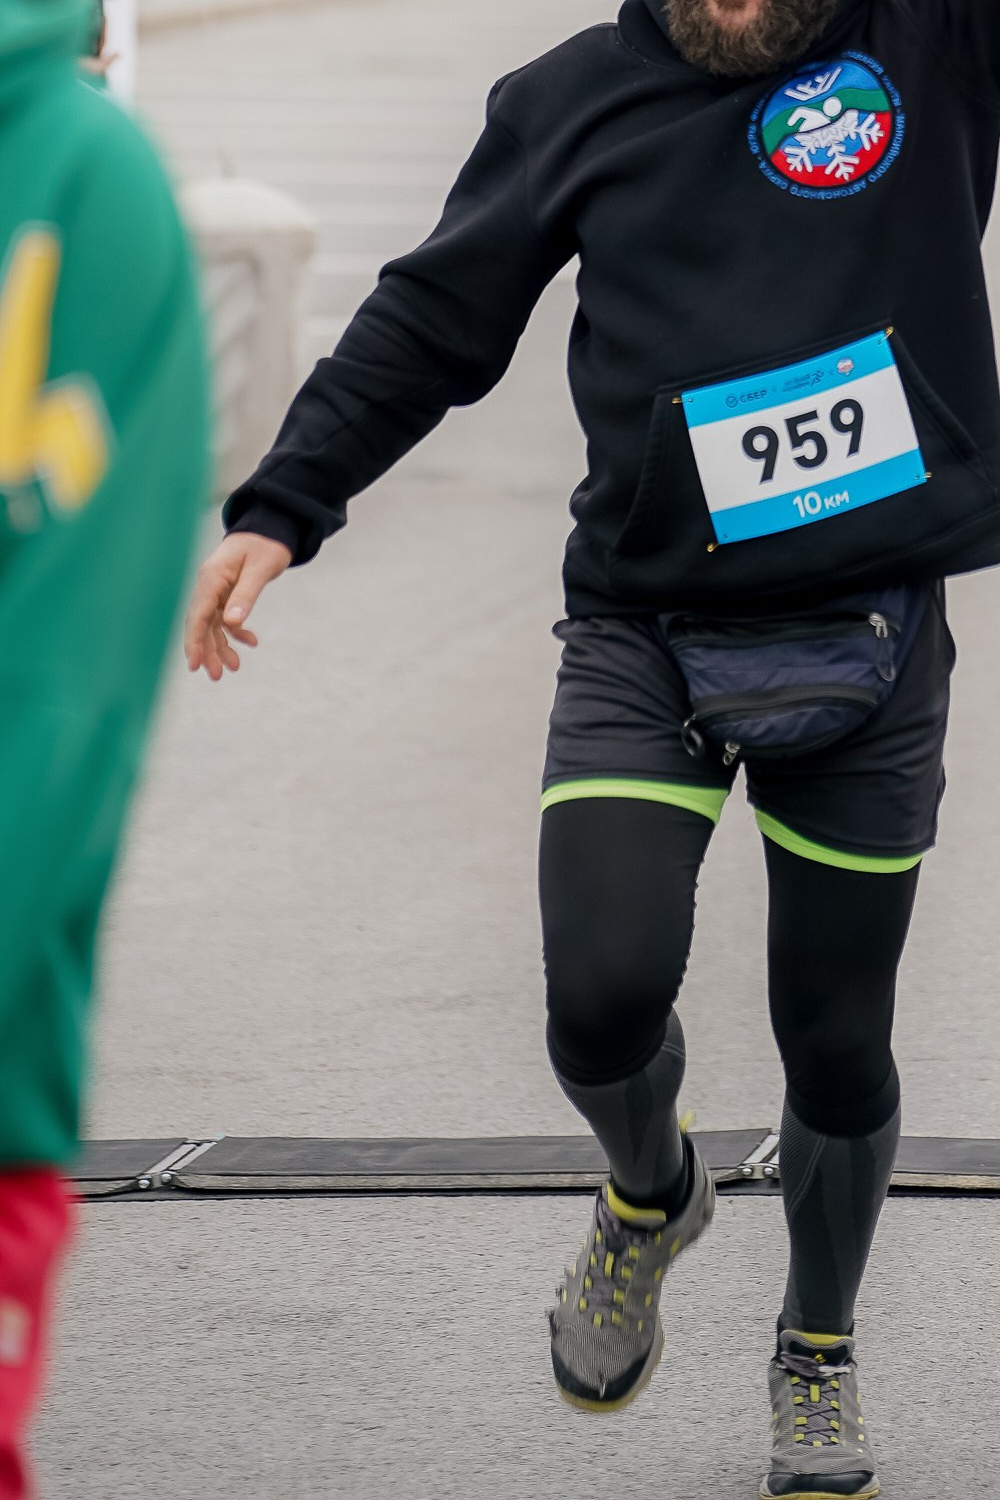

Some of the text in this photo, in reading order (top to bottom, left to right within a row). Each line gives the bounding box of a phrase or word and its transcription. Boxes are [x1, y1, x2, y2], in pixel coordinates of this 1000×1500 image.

[740, 389, 767, 404] СБЕР
[742, 398, 864, 485] 959
[793, 490, 822, 518] 10
